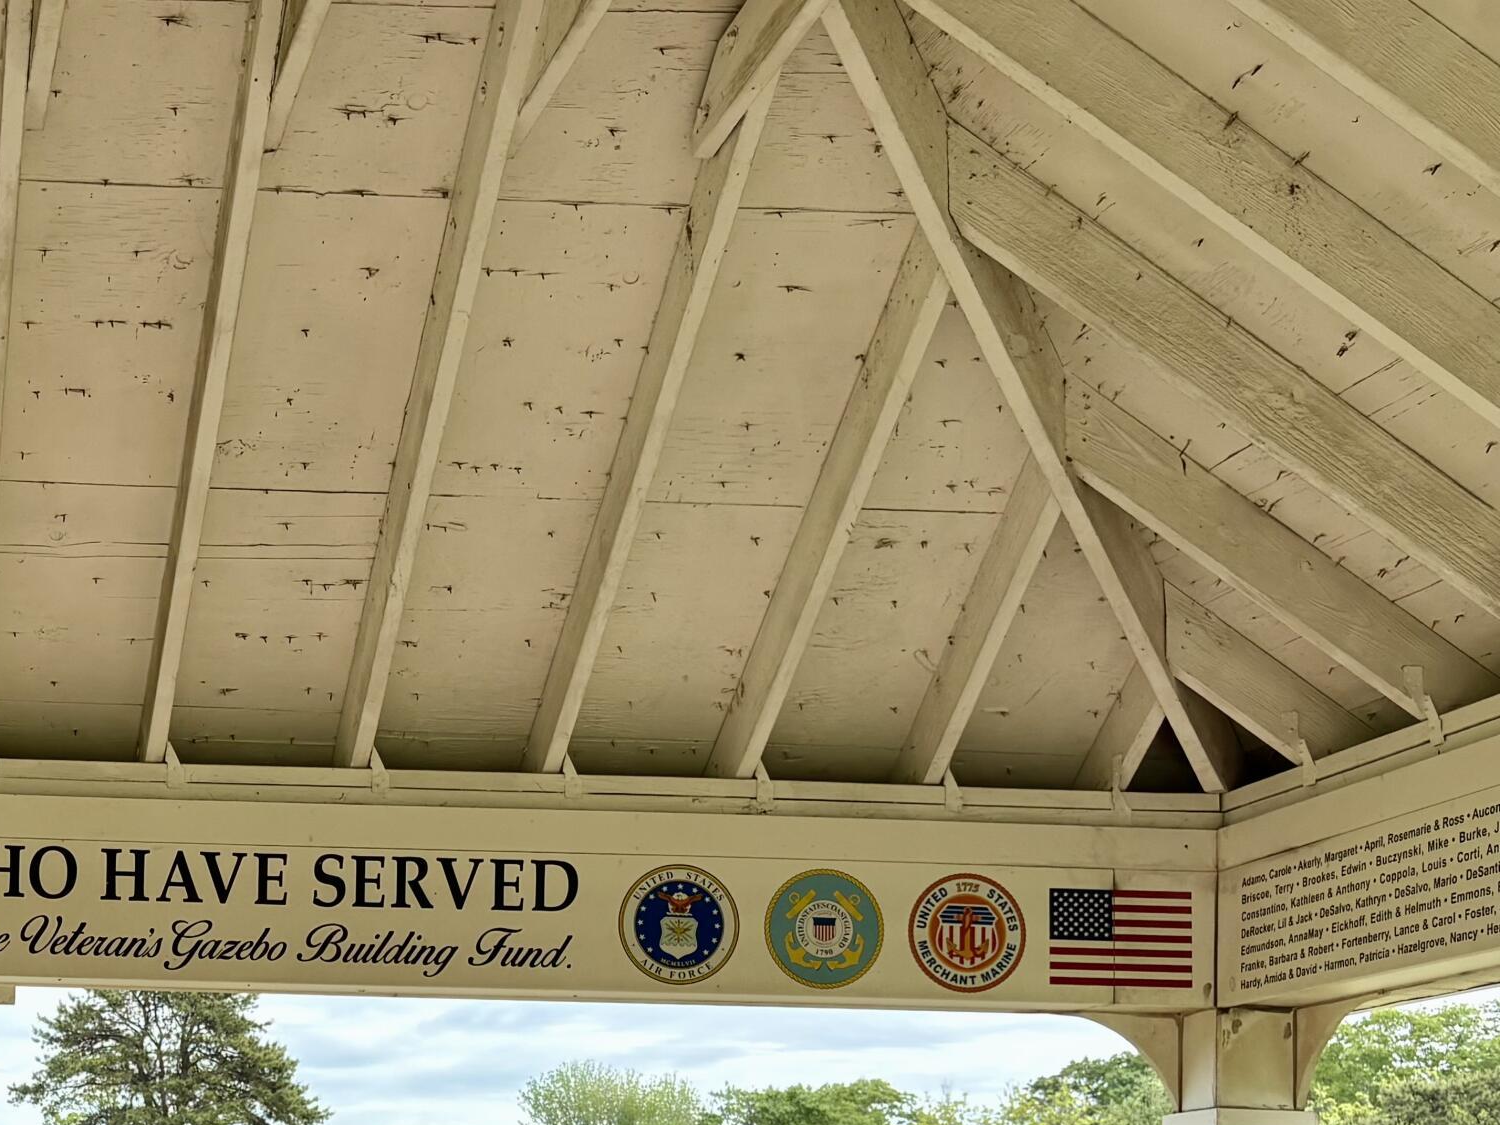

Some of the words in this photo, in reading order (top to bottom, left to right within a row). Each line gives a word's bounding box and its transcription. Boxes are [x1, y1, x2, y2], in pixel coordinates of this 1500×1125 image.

[99, 848, 288, 905] HAVE
[312, 854, 579, 911] SERVED
[1241, 890, 1272, 904] Briscoe,
[1275, 882, 1294, 896] Terry
[1302, 870, 1337, 887] Brookes,
[1341, 861, 1367, 877] Edwin
[1375, 844, 1424, 866] Buczynski,
[1428, 838, 1449, 852] Mike
[1459, 827, 1490, 843] Burke,
[1242, 873, 1267, 888] Adamo,
[1269, 865, 1292, 880] Carole
[1298, 856, 1322, 871] Akerly,
[1324, 845, 1358, 863] Margaret
[1364, 836, 1385, 852] April,
[1387, 823, 1431, 845] Rosemarie
[1434, 819, 1440, 831] &
[1442, 814, 1465, 829] Ross
[633, 871, 674, 900] UNITED
[685, 872, 725, 902] STATES
[916, 887, 948, 929] UNITED
[987, 888, 1019, 932] STATES
[956, 882, 980, 893] 1775
[1241, 903, 1288, 921] Constantino,
[1290, 892, 1324, 908] Kathleen
[1327, 888, 1333, 898] &
[1336, 879, 1371, 896] Anthony
[1380, 866, 1418, 884] Coppola,
[1421, 857, 1447, 873] Louis
[1457, 846, 1483, 863] Corti,
[1241, 922, 1275, 939] DeRocker,
[1277, 919, 1287, 930] Lil
[1289, 917, 1293, 926] &
[1296, 912, 1313, 925] Jack
[1320, 903, 1353, 918] DeSalvo,
[1355, 894, 1387, 909] Kathryn
[1394, 882, 1431, 899] DeSalvo,
[1433, 874, 1457, 889] Mario
[20, 914, 164, 958] Veteran's
[164, 919, 288, 971] Gazebo
[297, 923, 460, 977] Building
[467, 927, 573, 969] Fund.
[1240, 938, 1286, 956] Edmundson,
[1288, 927, 1323, 944] AnnaMay
[1331, 915, 1367, 933] Eickhoff,
[1370, 909, 1392, 923] Edith
[1395, 906, 1401, 917] &
[1405, 897, 1441, 915] Helmuth
[1450, 886, 1494, 904] Emmons,
[1240, 960, 1266, 973] Franke,
[1269, 951, 1298, 966] Barbara
[1300, 948, 1305, 958] &
[1308, 942, 1334, 957] Robert
[1341, 930, 1391, 949] Fortenberry,
[1394, 923, 1419, 937] Lance
[1422, 919, 1428, 930] &
[1431, 912, 1456, 928] Carol
[1464, 905, 1497, 920] Foster,
[641, 959, 662, 975] AIR
[669, 963, 713, 979] FORCE
[917, 940, 976, 985] MERCHANT
[980, 943, 1016, 982] MARINE
[1240, 978, 1262, 990] Hardy,
[1289, 969, 1294, 979] &
[1296, 963, 1317, 977] David
[1324, 956, 1357, 971] Harmon,
[1359, 948, 1390, 963] Patricia
[1397, 937, 1447, 955] Hazelgrove,
[1450, 928, 1478, 943] Nancy
